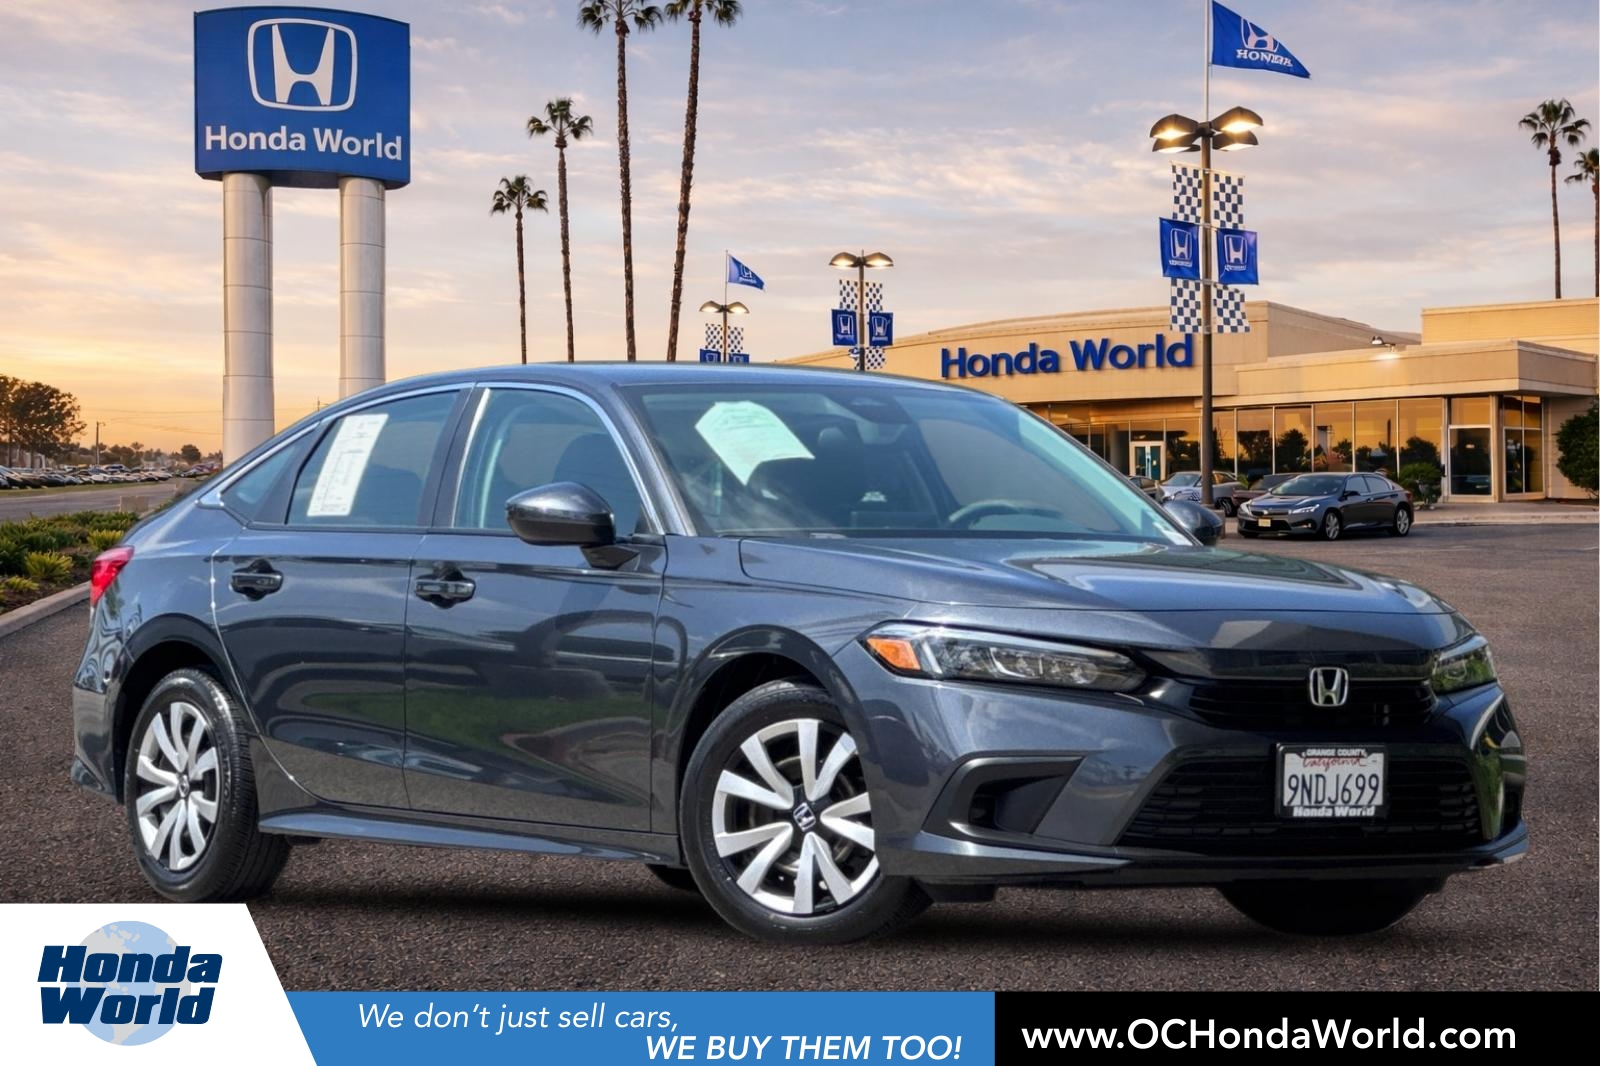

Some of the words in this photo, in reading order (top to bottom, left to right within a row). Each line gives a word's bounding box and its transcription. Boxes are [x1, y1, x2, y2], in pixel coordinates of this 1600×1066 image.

[205, 125, 306, 151] Honda
[313, 127, 402, 160] World
[941, 342, 1061, 377] Honda
[1069, 333, 1194, 371] World
[1302, 757, 1362, 772] California
[1286, 773, 1380, 806] 9NDJ699
[1293, 806, 1333, 817] Honda
[1334, 805, 1376, 817] World
